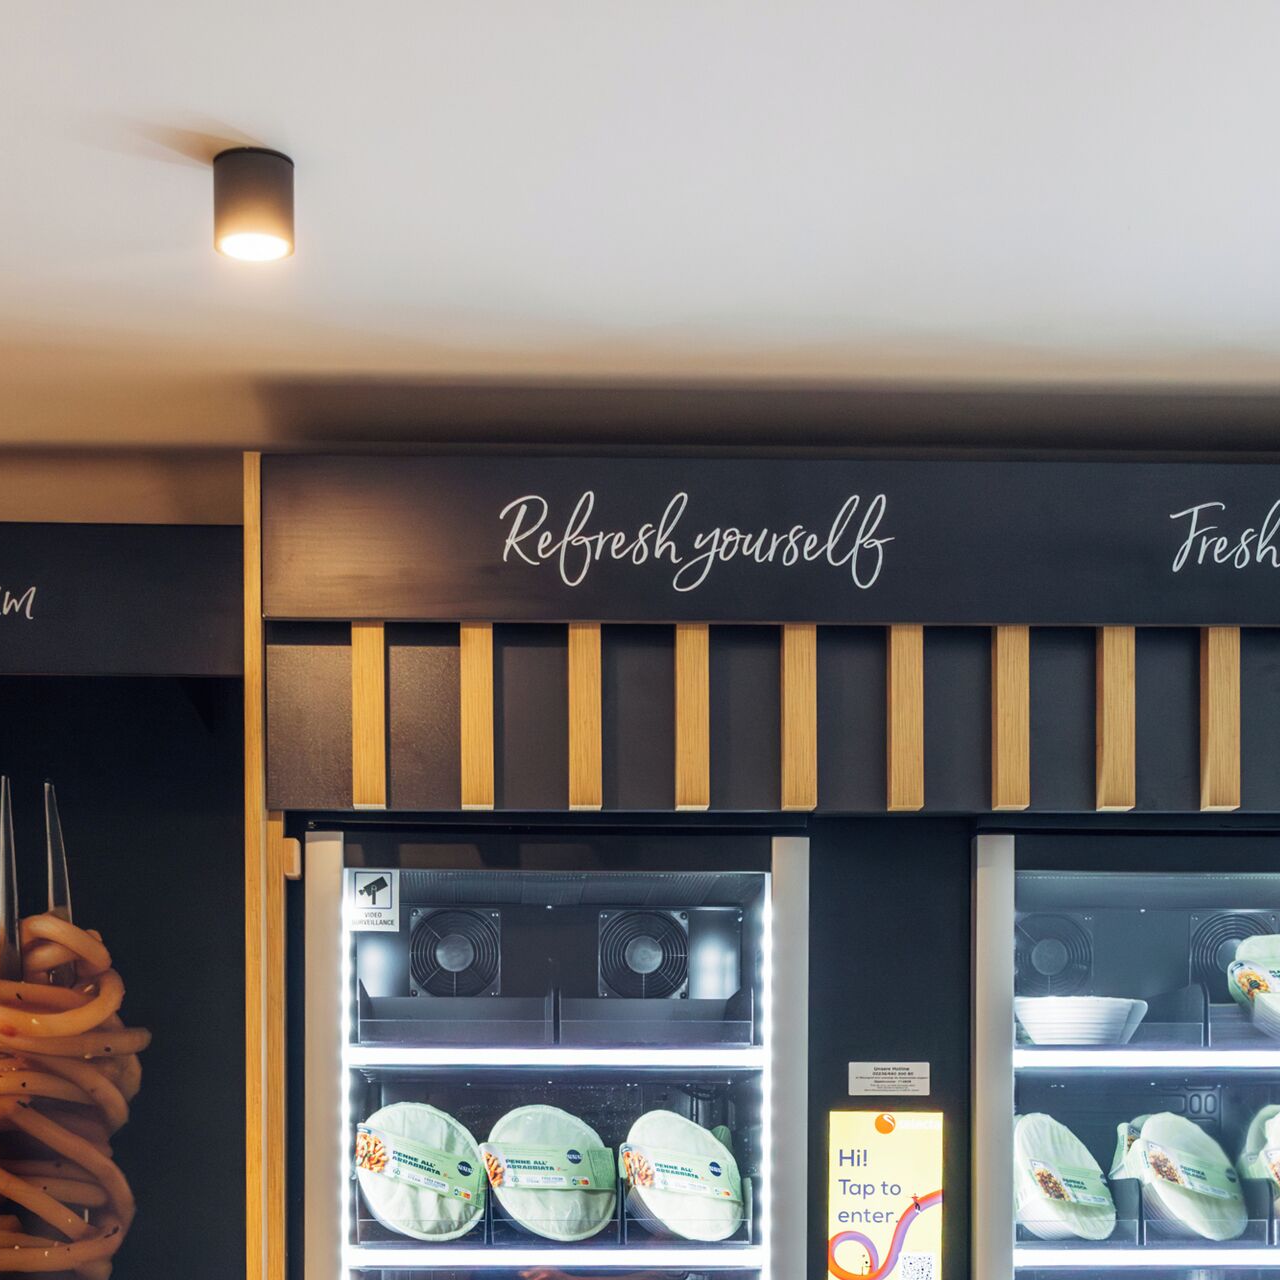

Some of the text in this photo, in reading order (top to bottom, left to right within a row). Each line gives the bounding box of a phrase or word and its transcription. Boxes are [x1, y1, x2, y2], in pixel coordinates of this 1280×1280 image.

[499, 491, 895, 592] Refresh yourself
[392, 1150, 419, 1162] PENNE
[392, 1155, 441, 1176] ARRABBIATA
[839, 1149, 867, 1167] Hi!
[838, 1179, 902, 1200] Tap to
[838, 1209, 899, 1223] enter.
